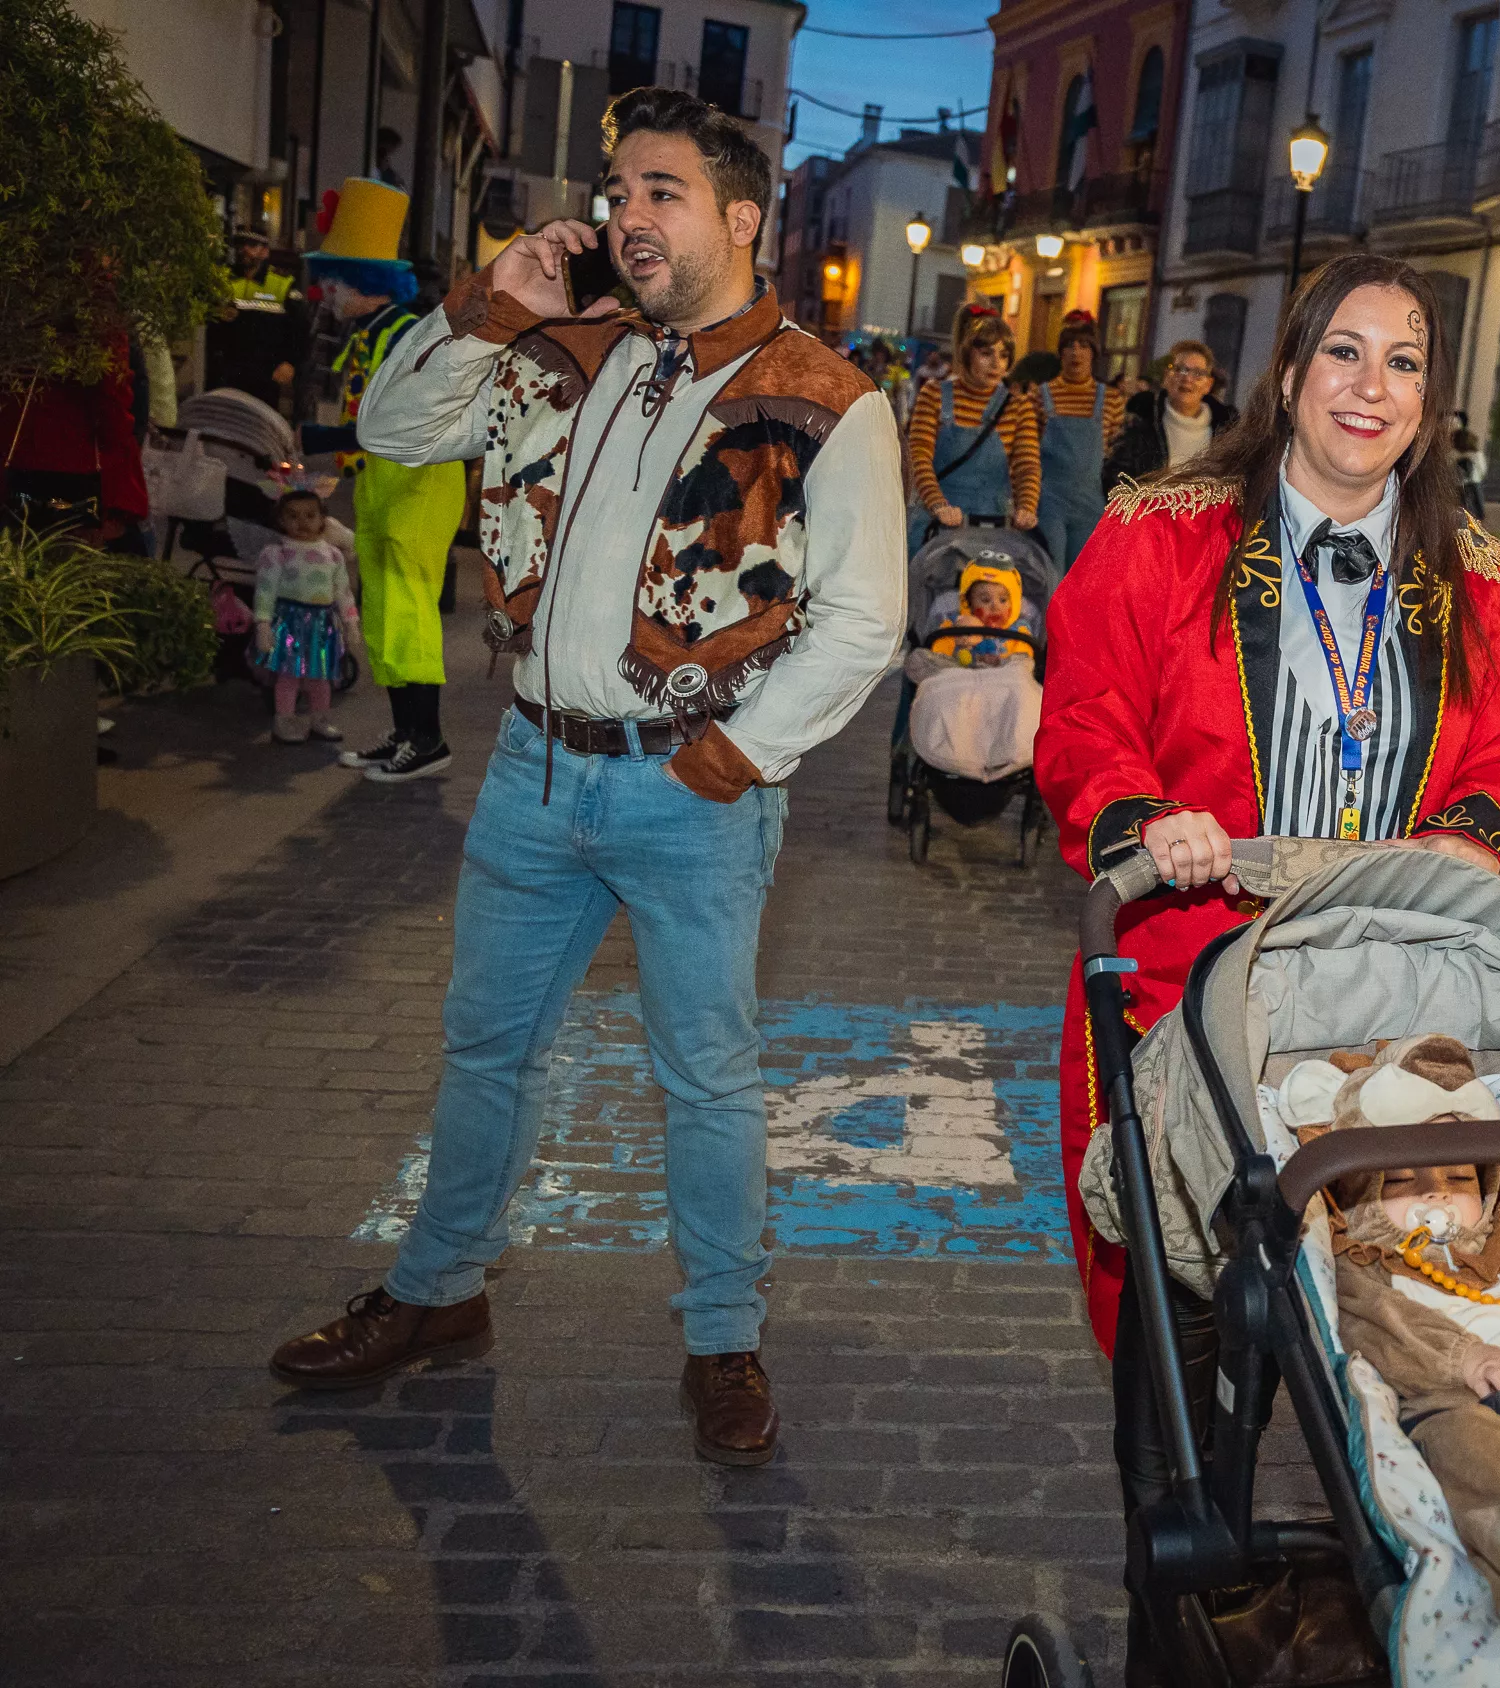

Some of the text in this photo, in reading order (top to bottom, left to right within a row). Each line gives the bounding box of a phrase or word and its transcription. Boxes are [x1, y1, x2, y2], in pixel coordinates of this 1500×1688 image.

[1319, 624, 1352, 715] CARNAVAL de CÁDIZ
[1359, 630, 1376, 674] CARNAVAL
[1356, 675, 1368, 689] de
